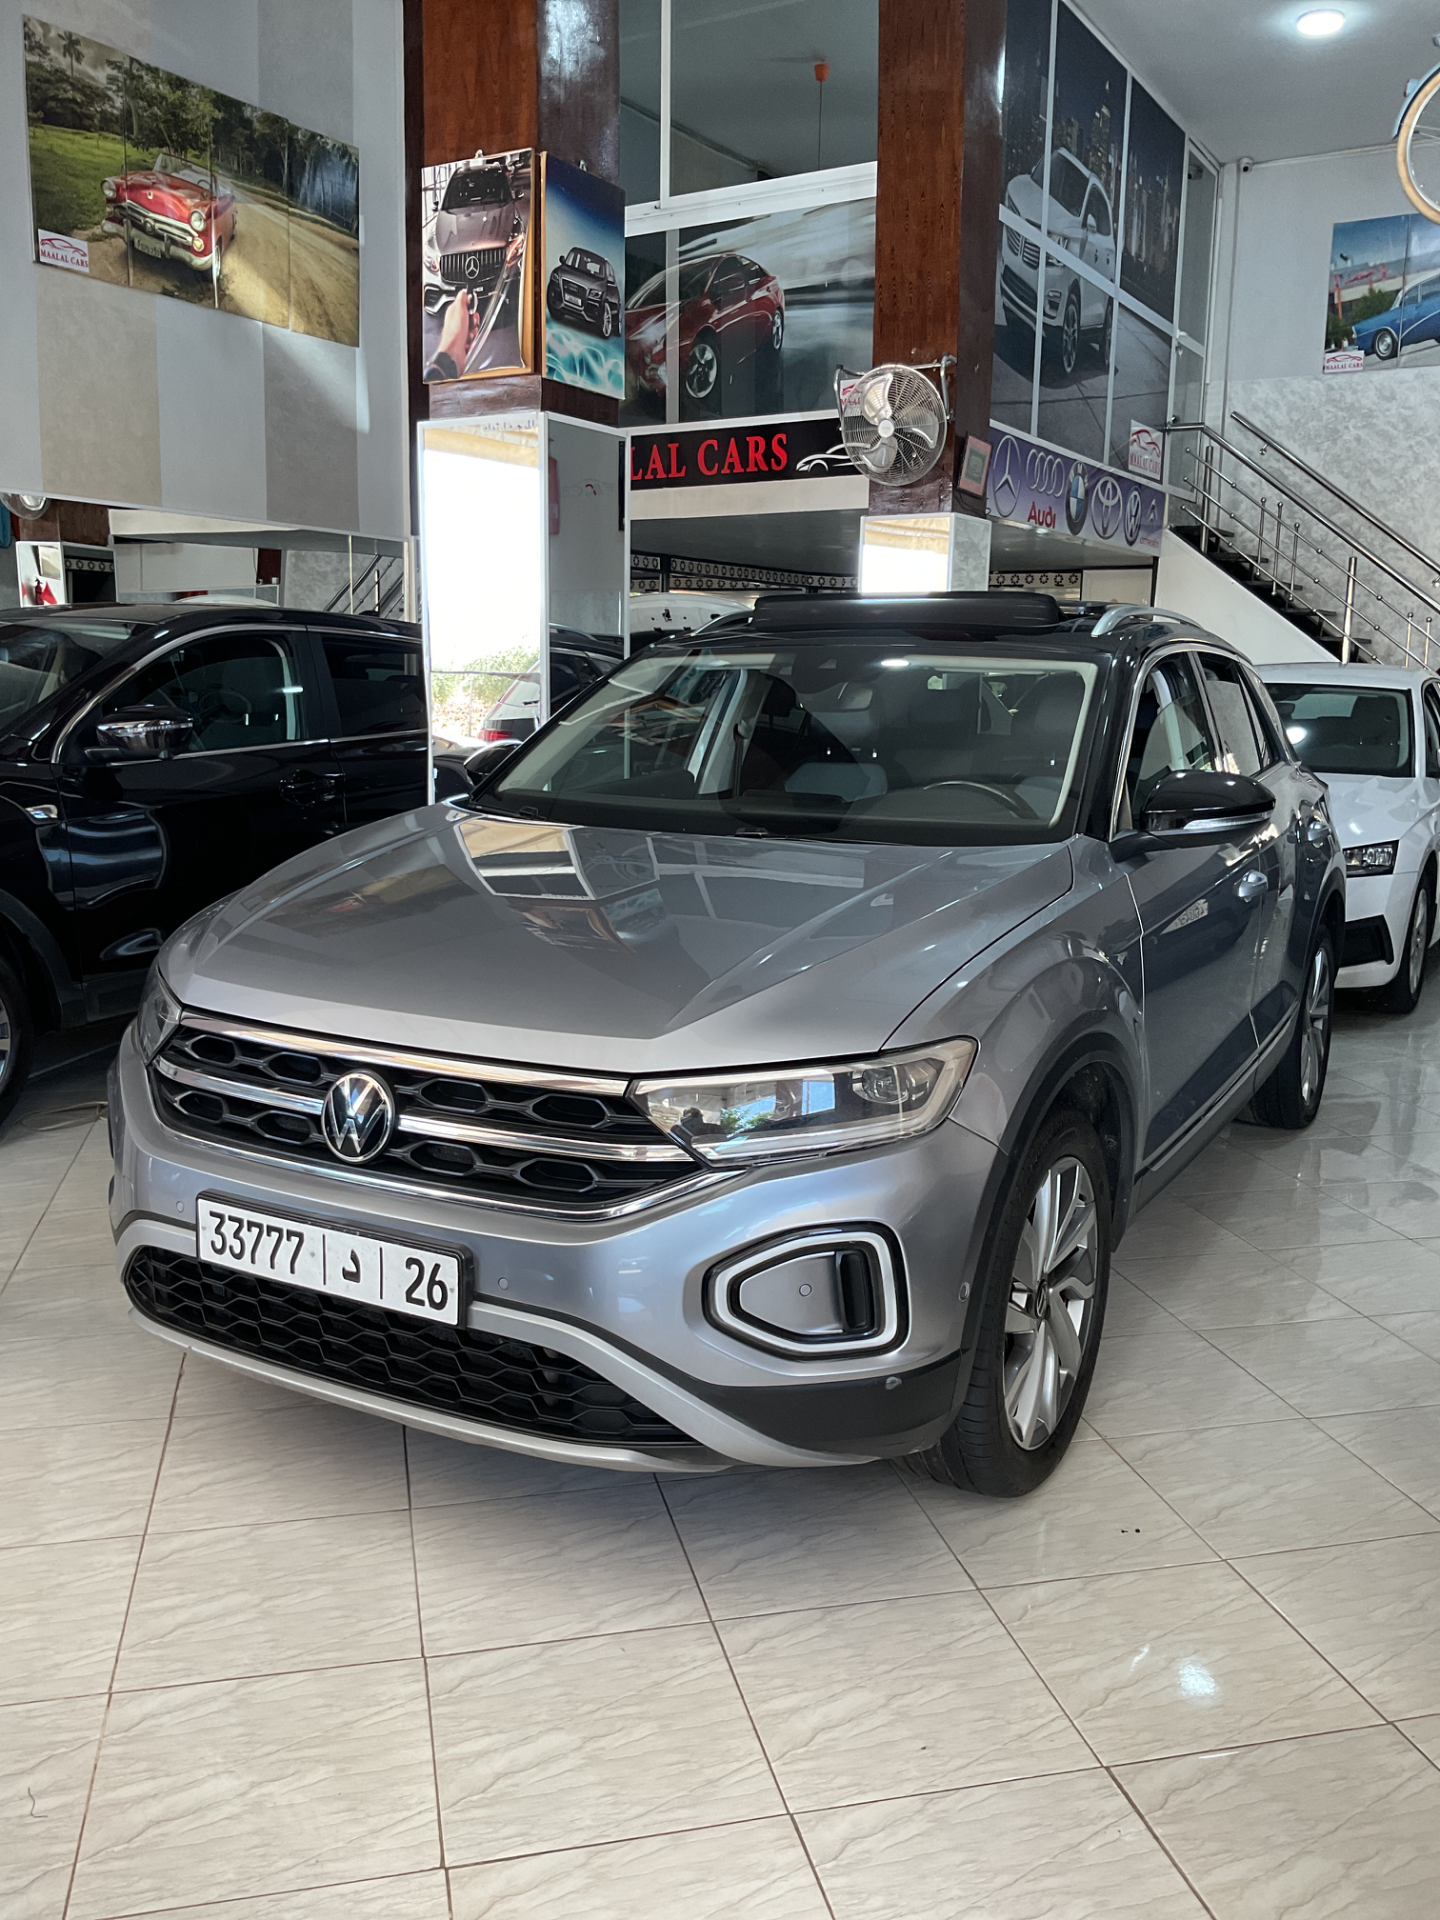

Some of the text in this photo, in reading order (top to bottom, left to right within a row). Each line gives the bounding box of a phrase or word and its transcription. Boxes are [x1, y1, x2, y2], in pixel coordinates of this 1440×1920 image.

[41, 249, 89, 268] MAALAL CARS
[1348, 361, 1363, 369] CARS
[697, 433, 788, 476] CARS
[1027, 501, 1056, 529] Audi
[209, 1210, 305, 1275] 33777
[341, 1249, 362, 1284] د
[405, 1256, 449, 1311] 26
